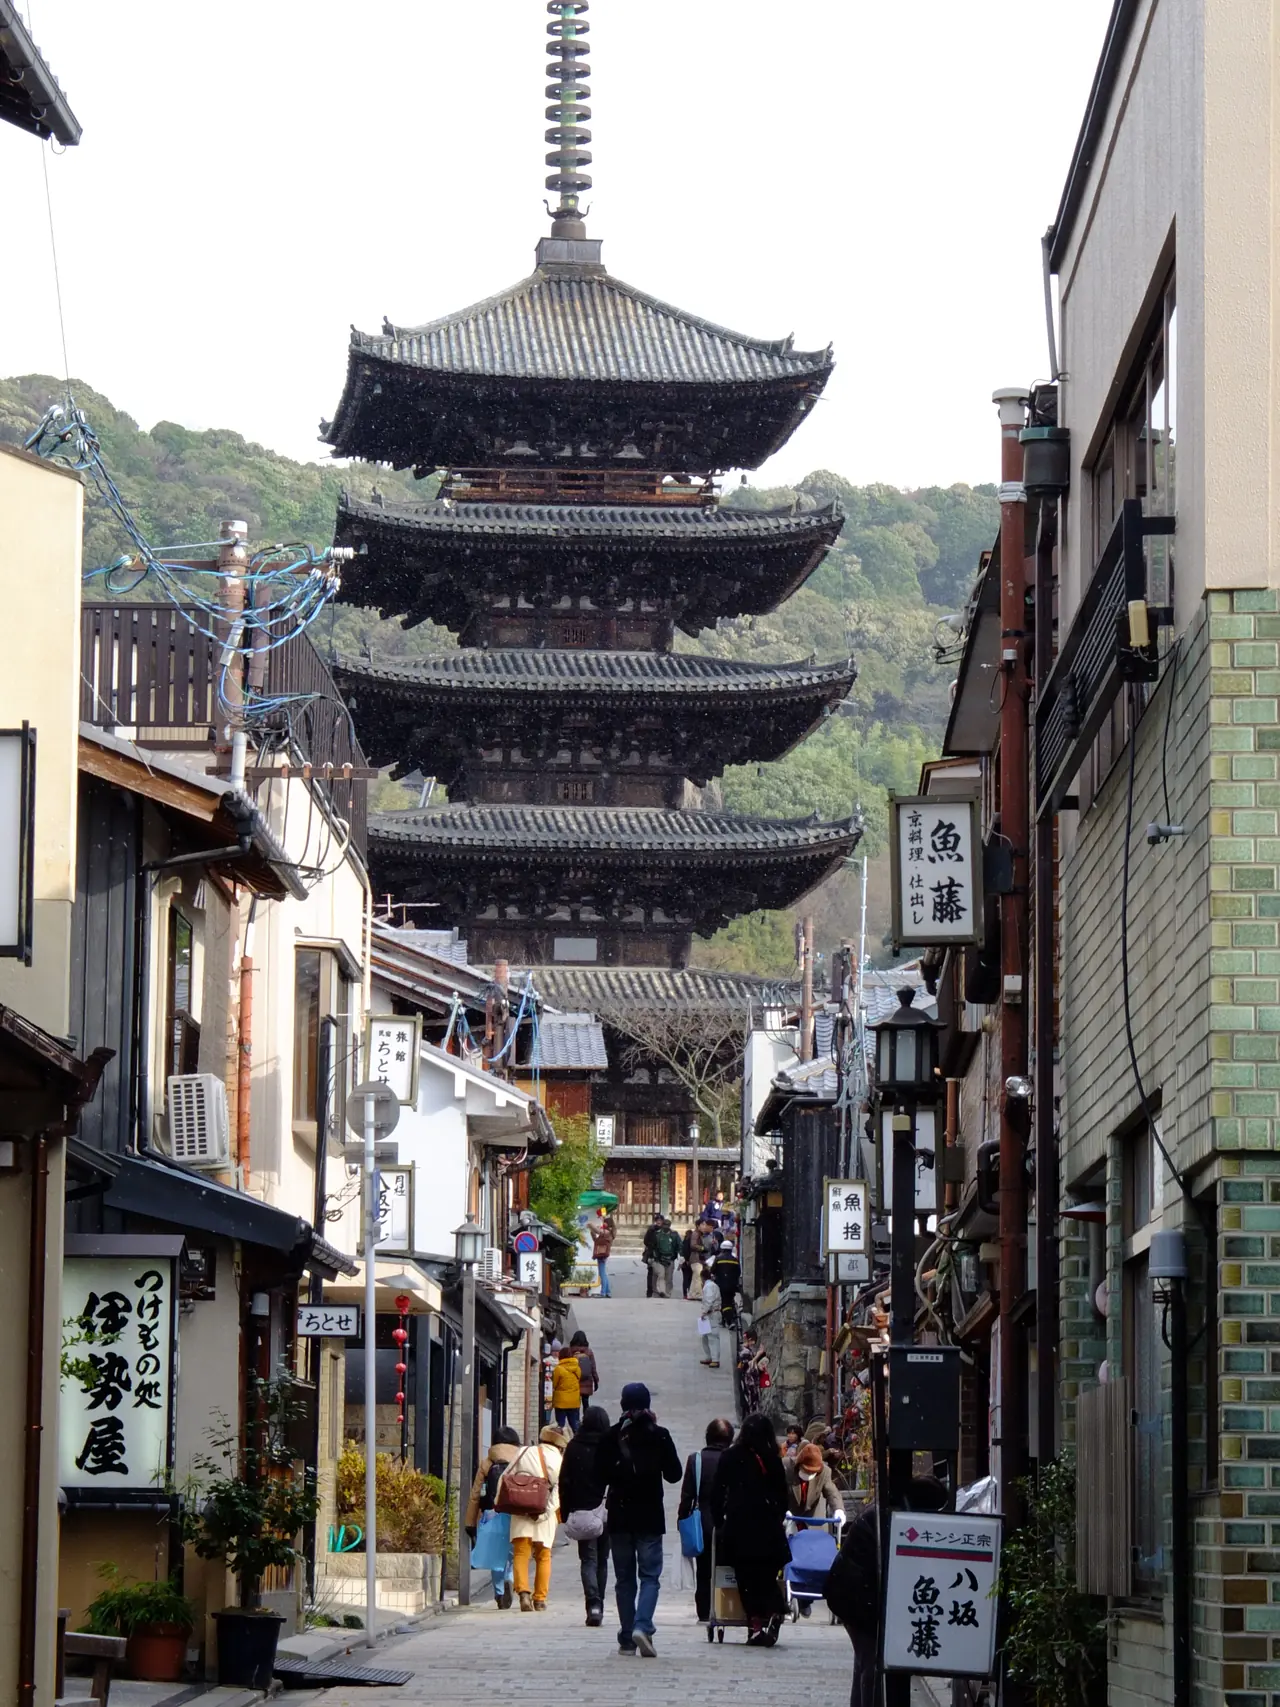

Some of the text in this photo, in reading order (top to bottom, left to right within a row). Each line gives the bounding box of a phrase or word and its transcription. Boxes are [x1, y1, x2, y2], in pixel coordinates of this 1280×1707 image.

[907, 810, 925, 925] 京料理・仕出し
[927, 818, 968, 924] 魚藤
[395, 1031, 409, 1062] 旅館
[831, 1186, 842, 1212] 鮮魚
[842, 1193, 862, 1241] 魚捨
[131, 1269, 164, 1409] つけもの処
[305, 1312, 353, 1332] ちとせ
[75, 1290, 133, 1476] 伊勢屋
[919, 1529, 992, 1548] キンシ正宗
[907, 1574, 945, 1660] 魚藤
[947, 1567, 980, 1629] 八坂
